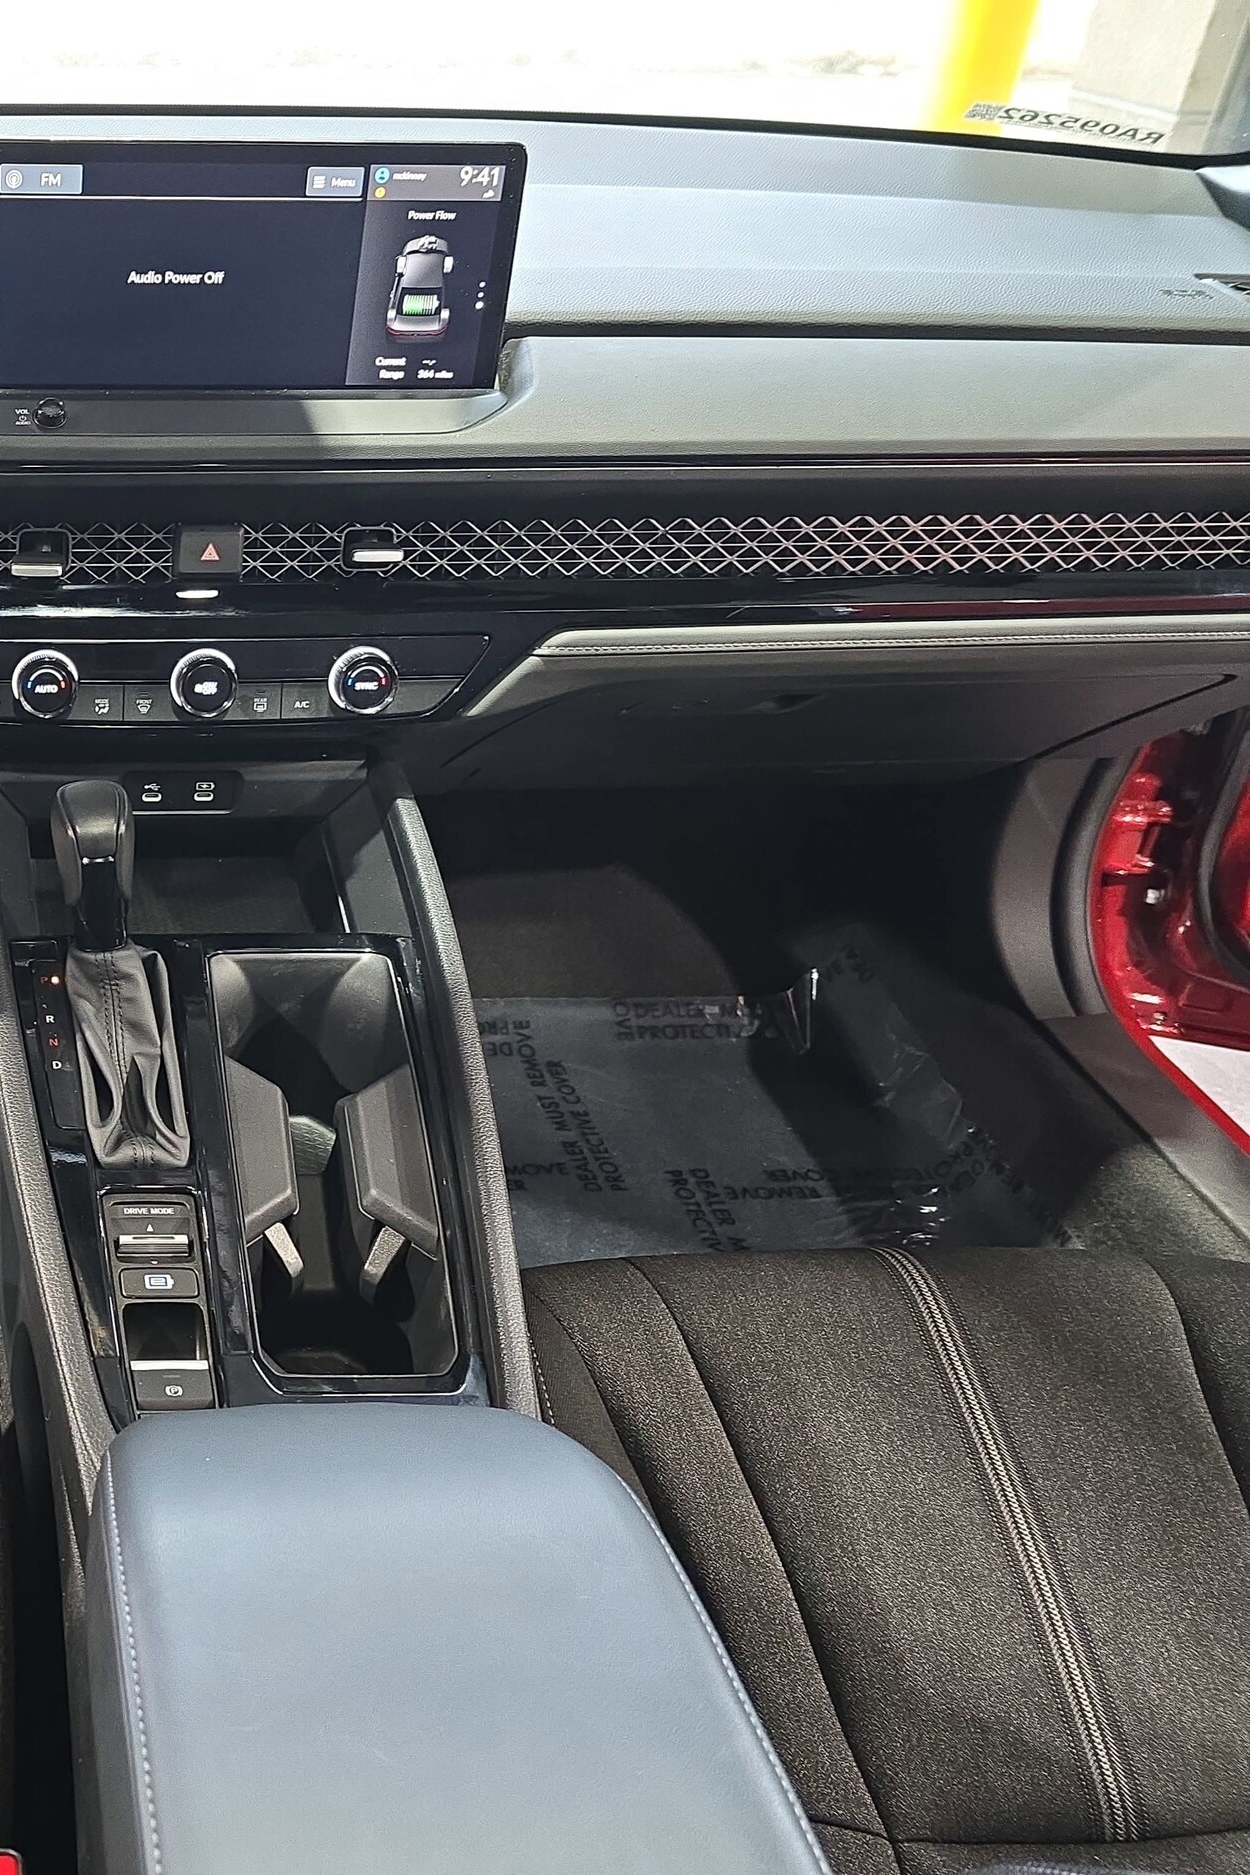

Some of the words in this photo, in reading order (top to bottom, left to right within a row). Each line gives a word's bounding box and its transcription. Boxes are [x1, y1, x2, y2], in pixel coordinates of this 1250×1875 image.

[40, 172, 61, 186] FM
[460, 166, 499, 187] 9:41
[331, 177, 356, 188] Menu
[407, 210, 434, 220] Power
[435, 210, 457, 220] Flow
[127, 271, 162, 284] Audio
[164, 271, 202, 284] Power
[204, 271, 225, 284] Off
[375, 357, 406, 366] Current
[34, 684, 58, 693] AUTO
[354, 681, 379, 690] SYNC
[46, 1015, 55, 1023] R
[52, 1061, 62, 1070] D
